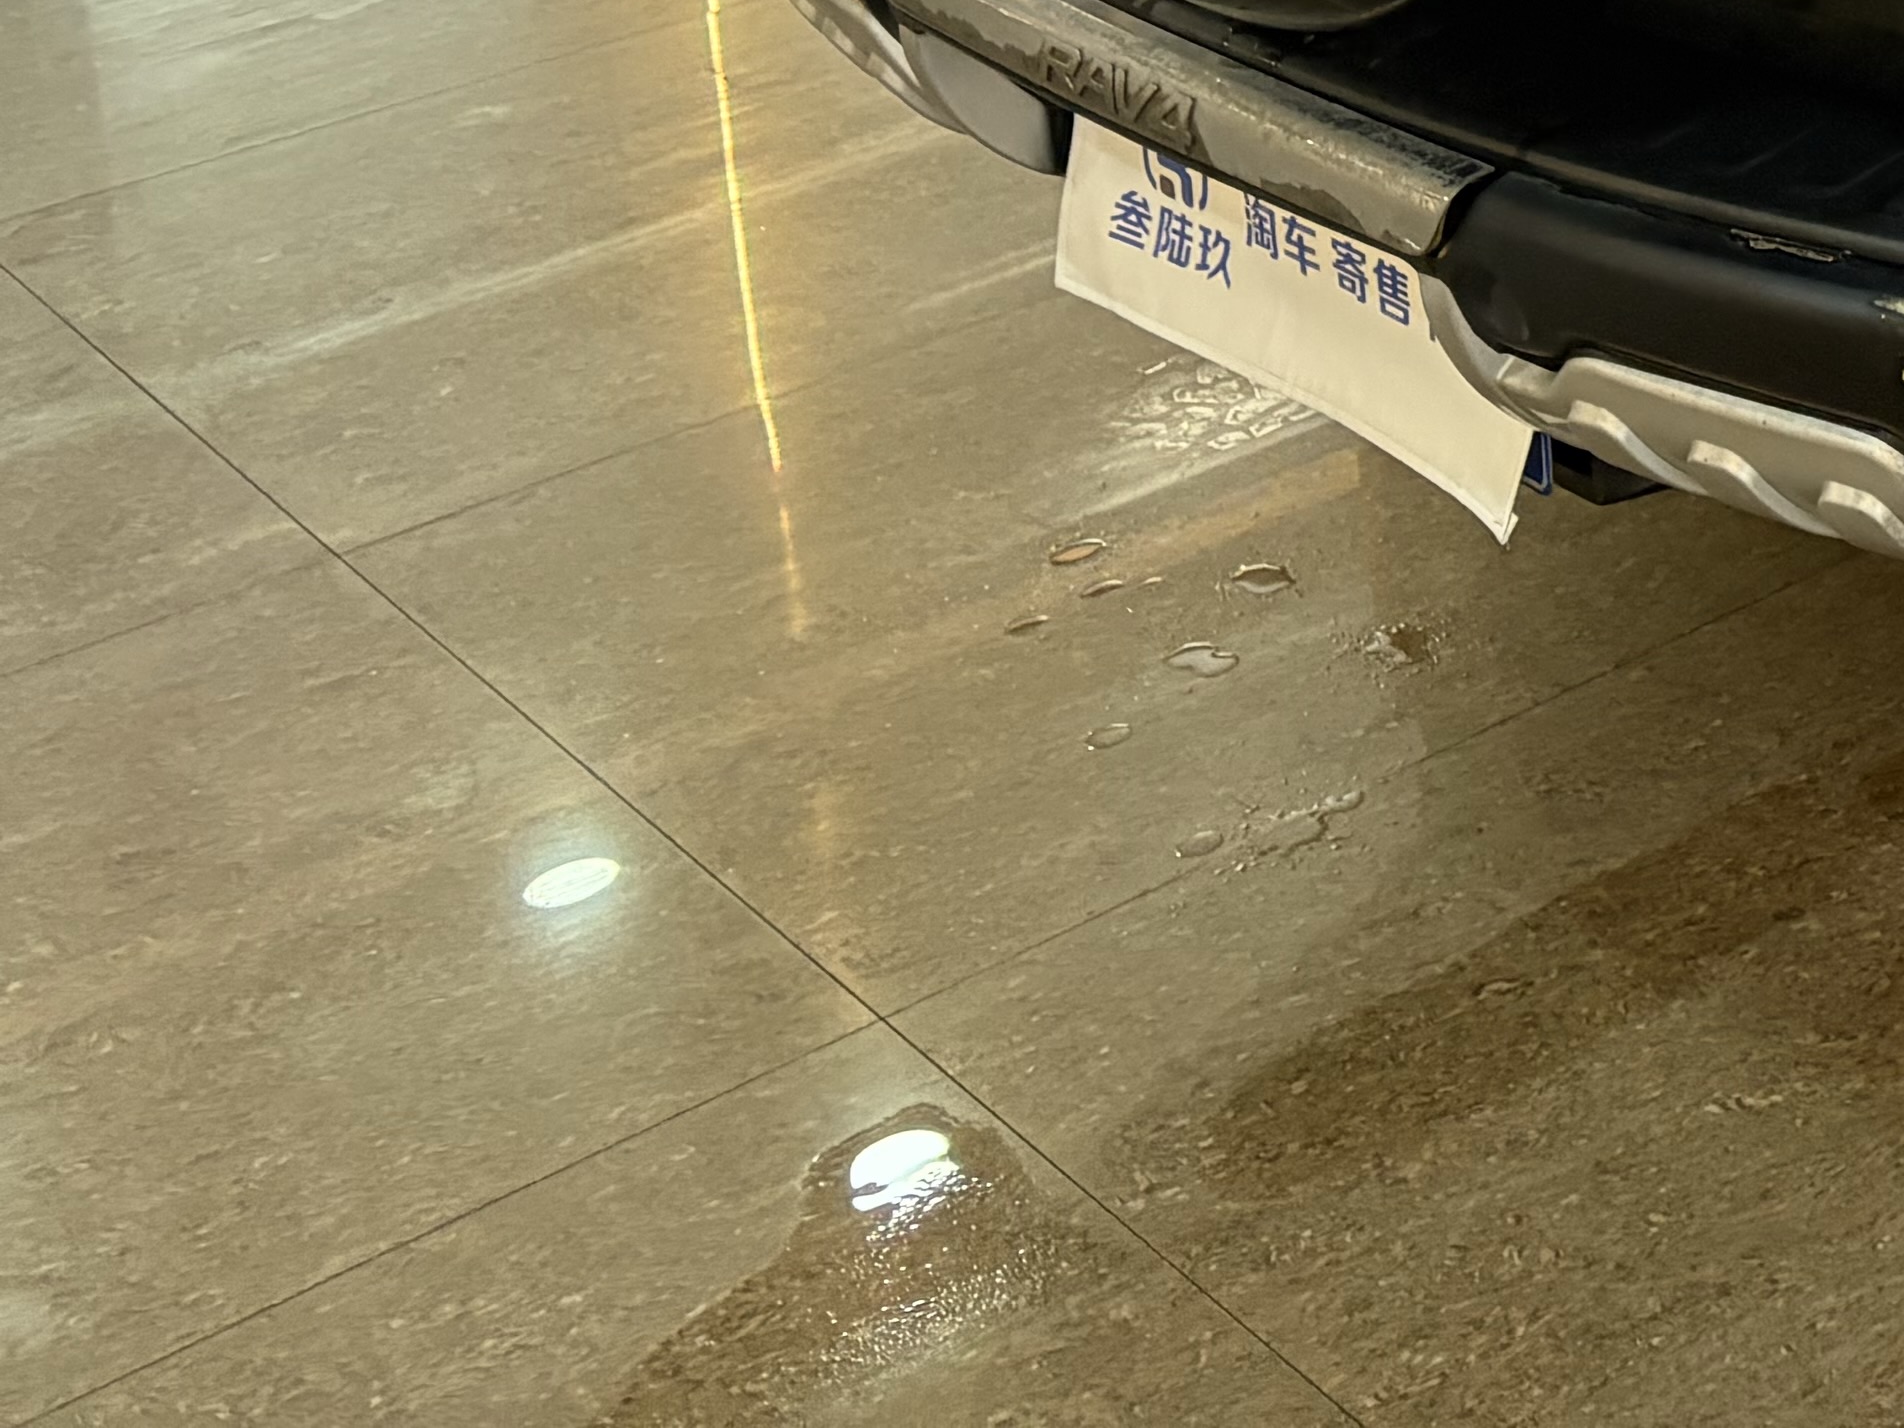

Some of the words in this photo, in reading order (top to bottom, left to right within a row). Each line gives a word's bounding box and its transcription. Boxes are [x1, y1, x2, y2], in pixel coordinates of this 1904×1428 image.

[1041, 38, 1197, 154] RAV4
[1108, 189, 1232, 289] 叁陆玖
[1243, 192, 1321, 276] 淘车
[1329, 235, 1411, 326] 寄售
